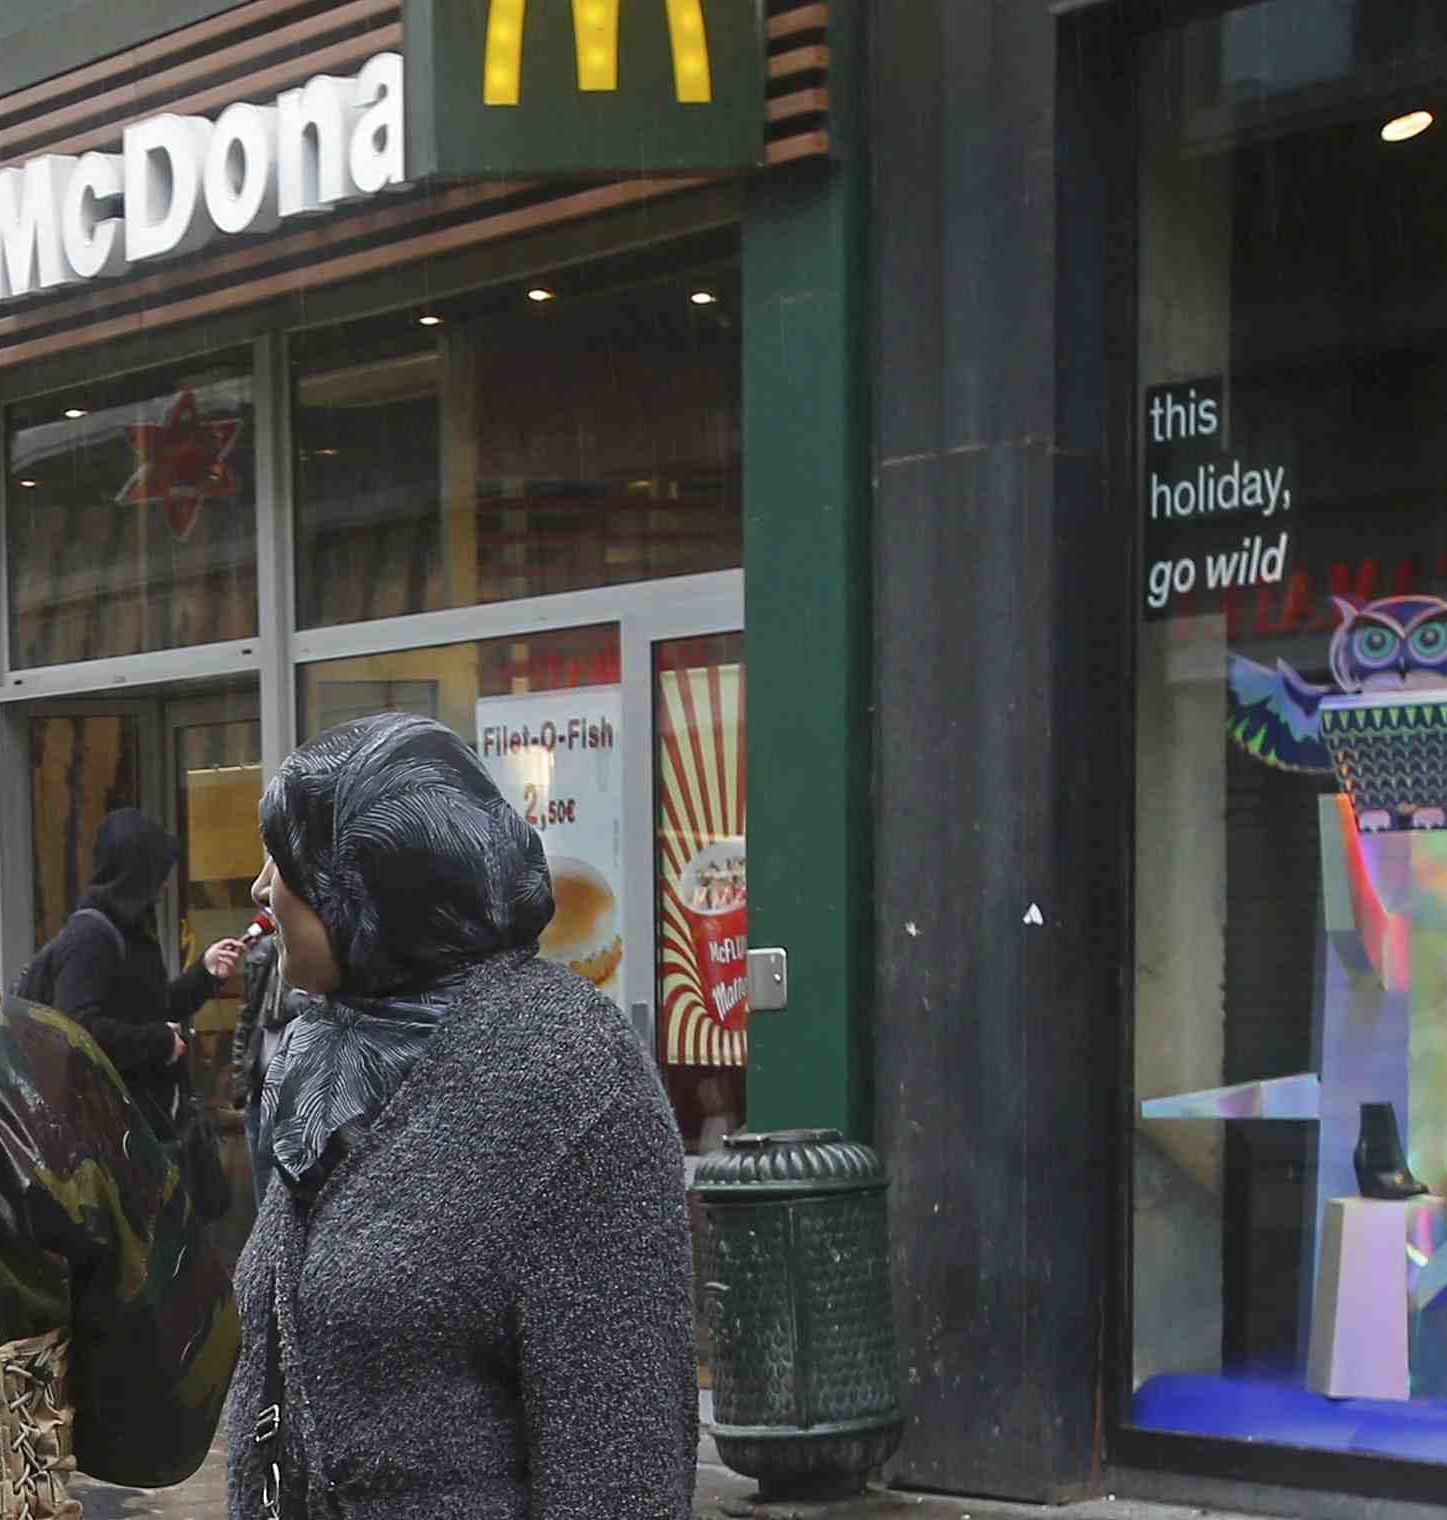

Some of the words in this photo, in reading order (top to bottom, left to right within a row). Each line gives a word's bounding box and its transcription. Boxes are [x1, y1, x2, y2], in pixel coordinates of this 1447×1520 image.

[1149, 388, 1219, 443] this
[1151, 460, 1291, 520] holiday,
[1148, 557, 1197, 608] go
[1205, 531, 1288, 590] wild
[483, 716, 614, 758] Filet-O-Fish
